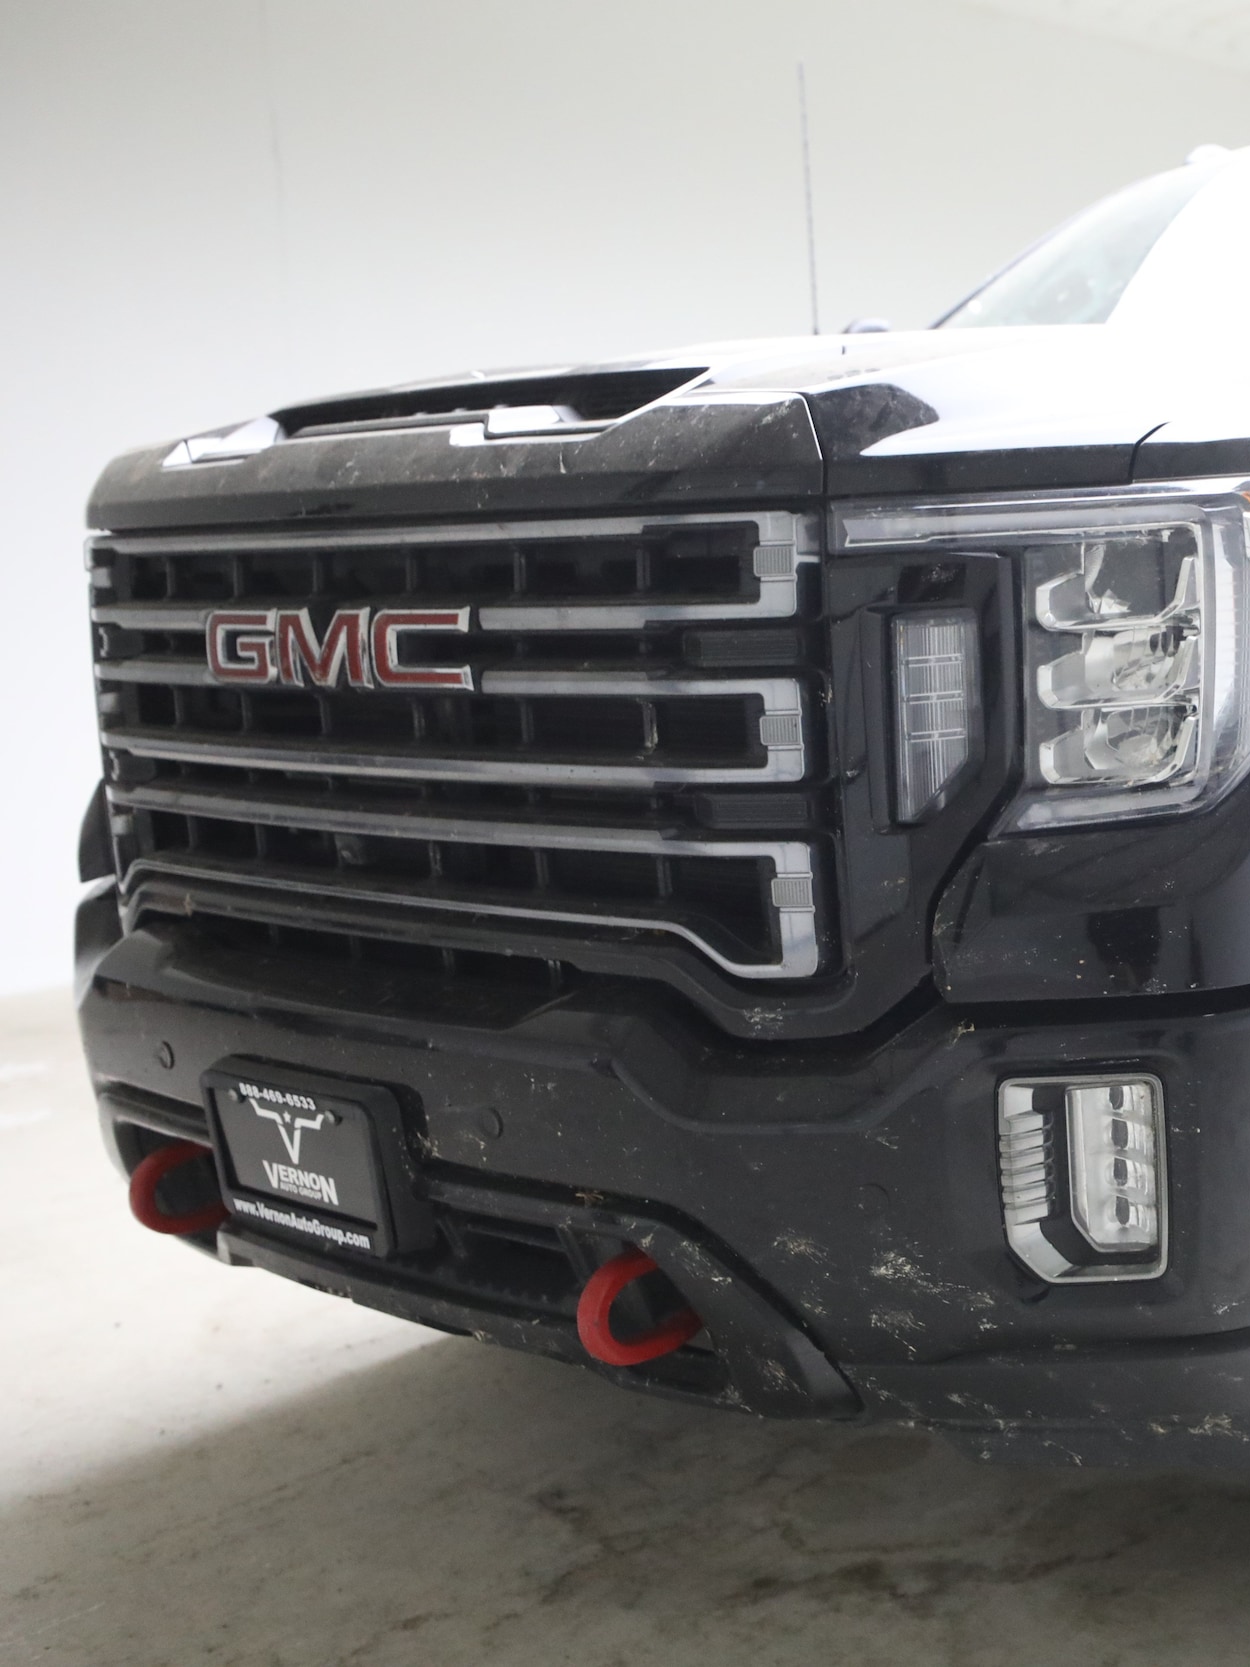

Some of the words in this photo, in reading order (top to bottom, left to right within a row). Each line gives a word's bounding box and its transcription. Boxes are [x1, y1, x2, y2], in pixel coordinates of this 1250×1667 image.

[206, 606, 474, 691] GMC
[239, 1082, 316, 1110] 888-469-6533
[262, 1160, 339, 1206] VERNON
[280, 1182, 299, 1194] AUTO
[298, 1187, 323, 1200] GROUP
[233, 1198, 371, 1250] www.VernonAutoGroup.com
